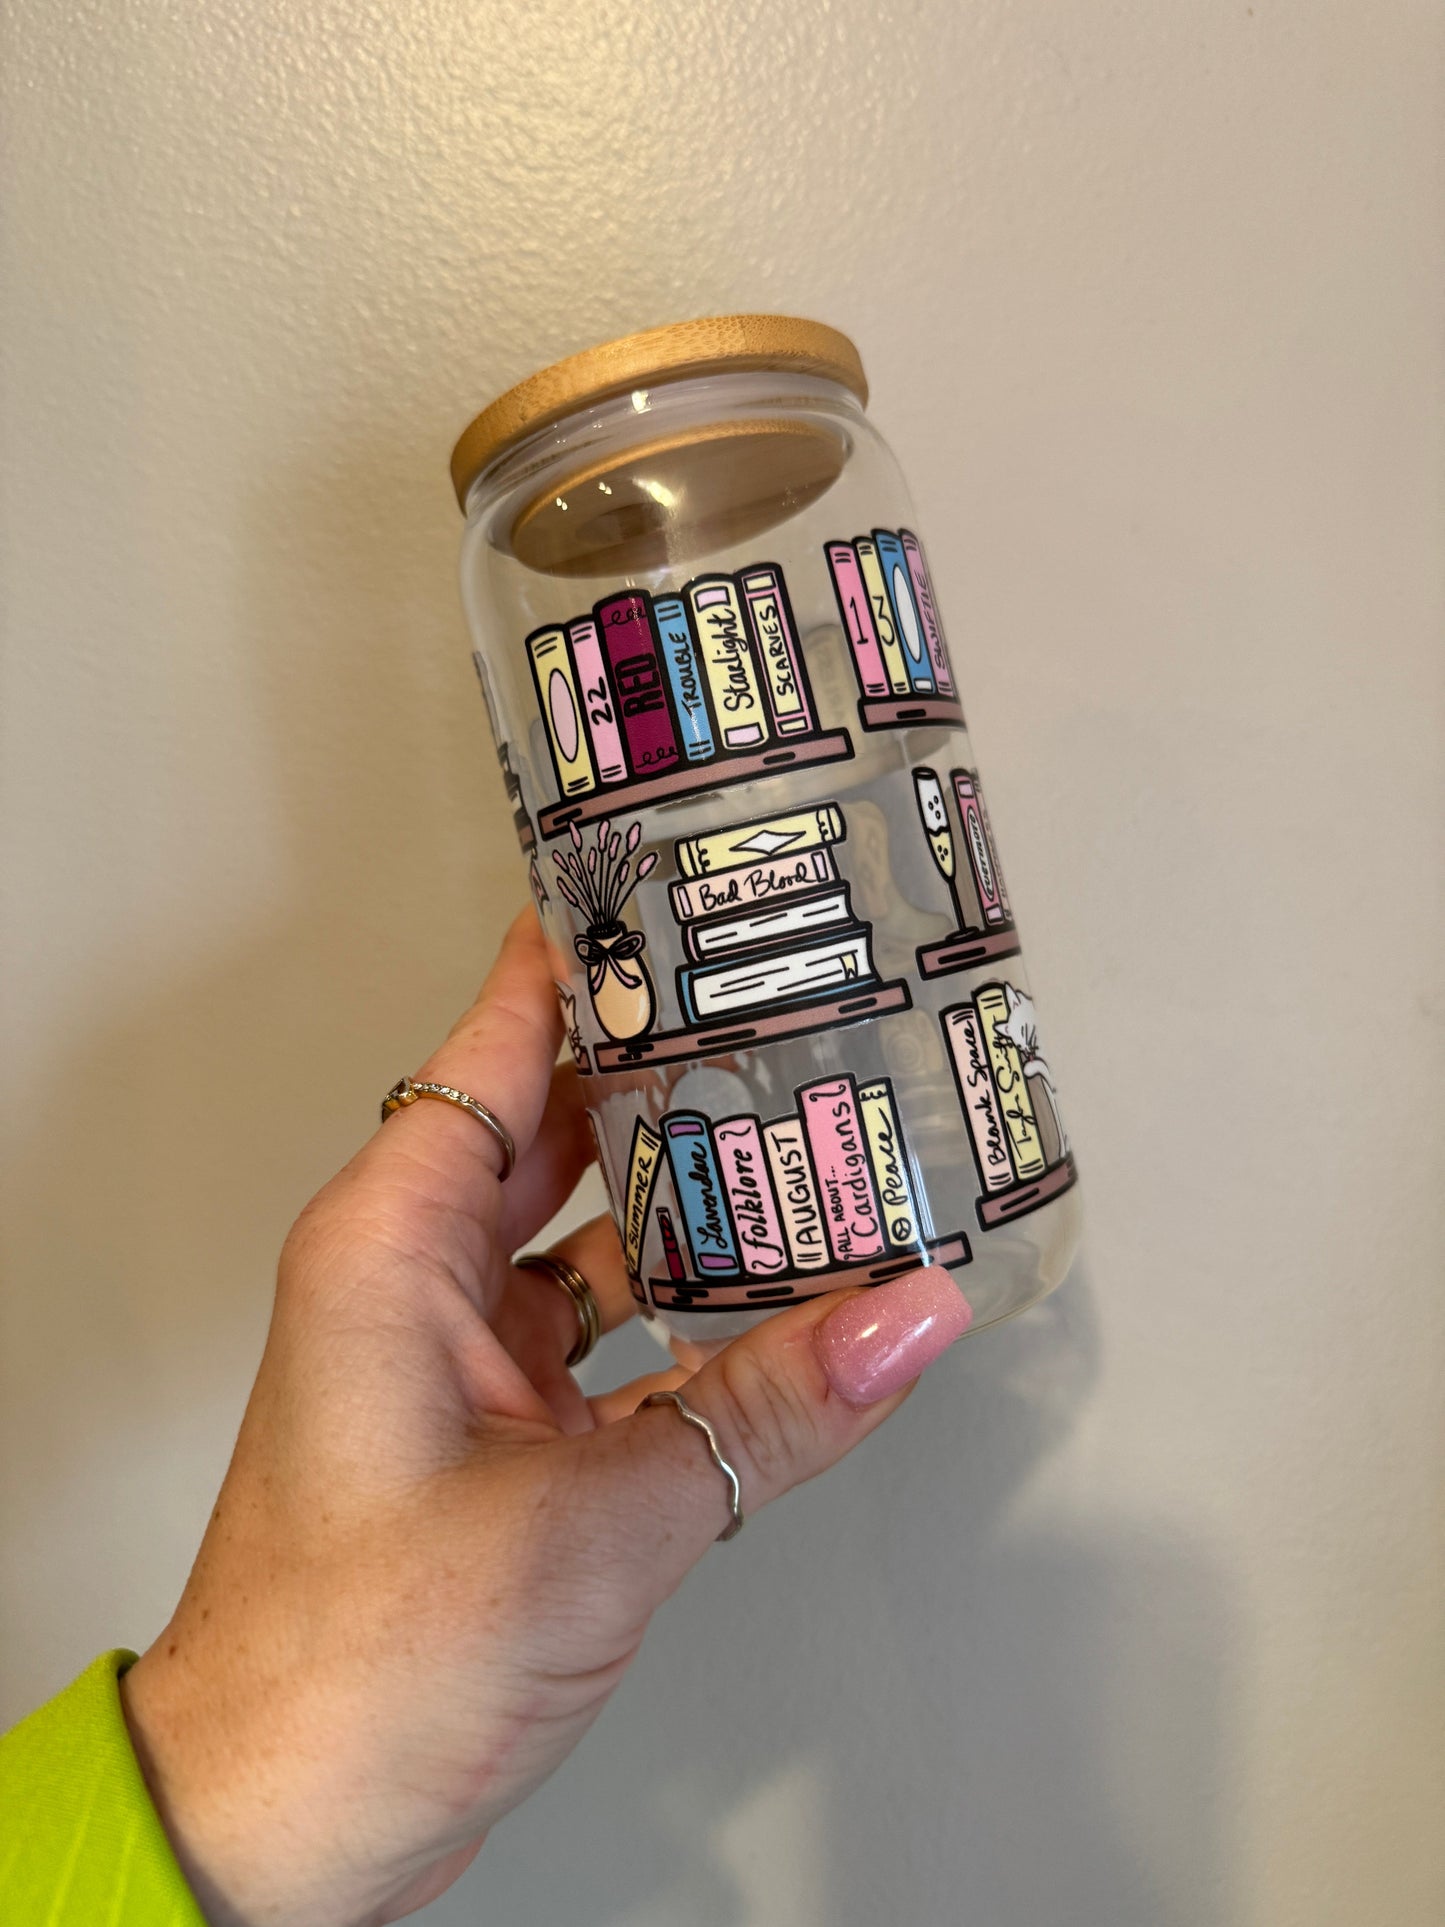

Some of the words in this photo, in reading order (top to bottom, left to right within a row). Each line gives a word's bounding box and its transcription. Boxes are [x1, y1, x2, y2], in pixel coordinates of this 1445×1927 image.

[707, 608, 755, 712] Starlight
[759, 604, 794, 696] SCARVES
[872, 595, 895, 647] 3
[914, 570, 945, 670] SWIFTIE
[587, 675, 613, 727] 22
[614, 652, 665, 718] RED
[669, 632, 702, 717] TROUBLE
[699, 881, 742, 911] Bad
[743, 862, 817, 898] Blood
[963, 1020, 989, 1088] Space
[689, 1141, 728, 1249] Lavender
[770, 1131, 822, 1246] AUGUST
[832, 1101, 879, 1238] Cardigans
[878, 1106, 908, 1206] Peace
[731, 1148, 784, 1260] folklore
[837, 1228, 853, 1253] ALL
